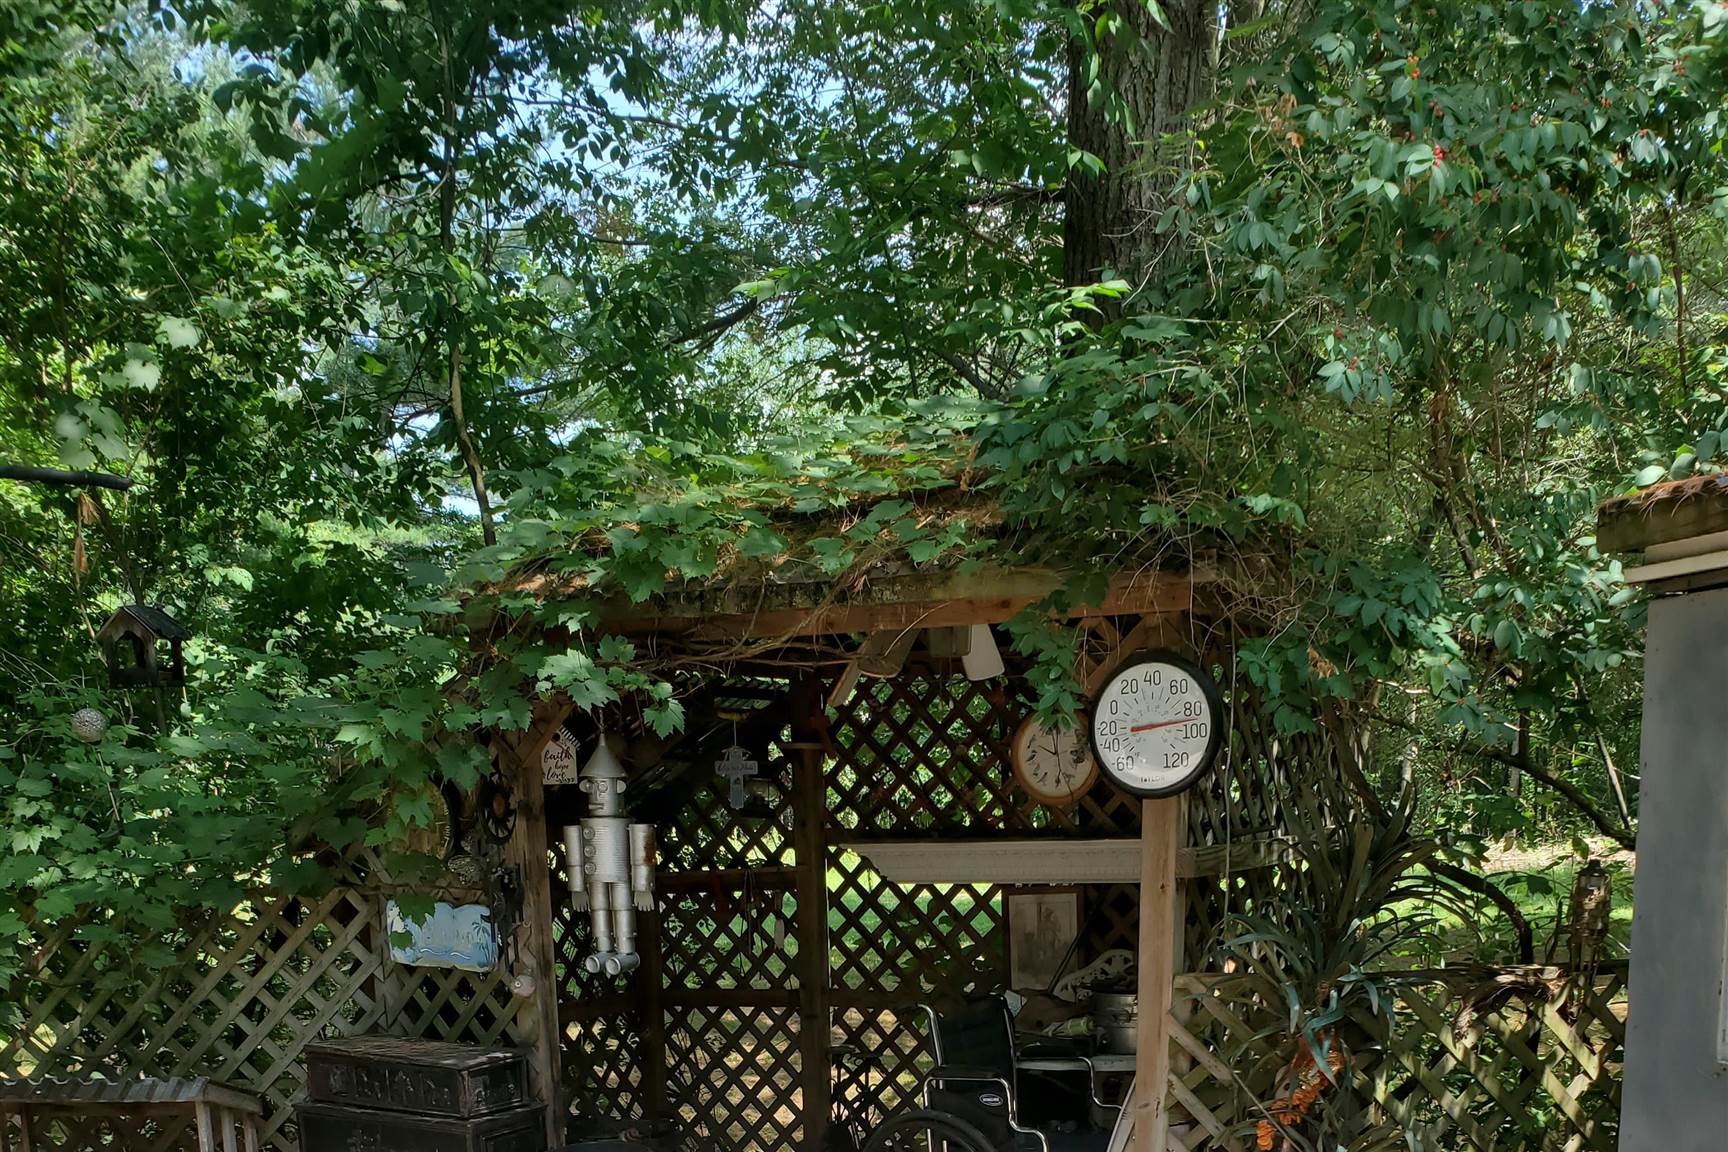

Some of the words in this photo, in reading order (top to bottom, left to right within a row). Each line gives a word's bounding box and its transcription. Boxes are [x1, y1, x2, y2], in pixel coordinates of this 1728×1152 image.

[1143, 670, 1161, 686] 40
[1121, 679, 1138, 694] 20
[1170, 679, 1188, 695] 60
[1110, 700, 1118, 715] 0
[1183, 701, 1202, 716] 80
[1183, 723, 1207, 739] 100
[1163, 752, 1189, 768] 120
